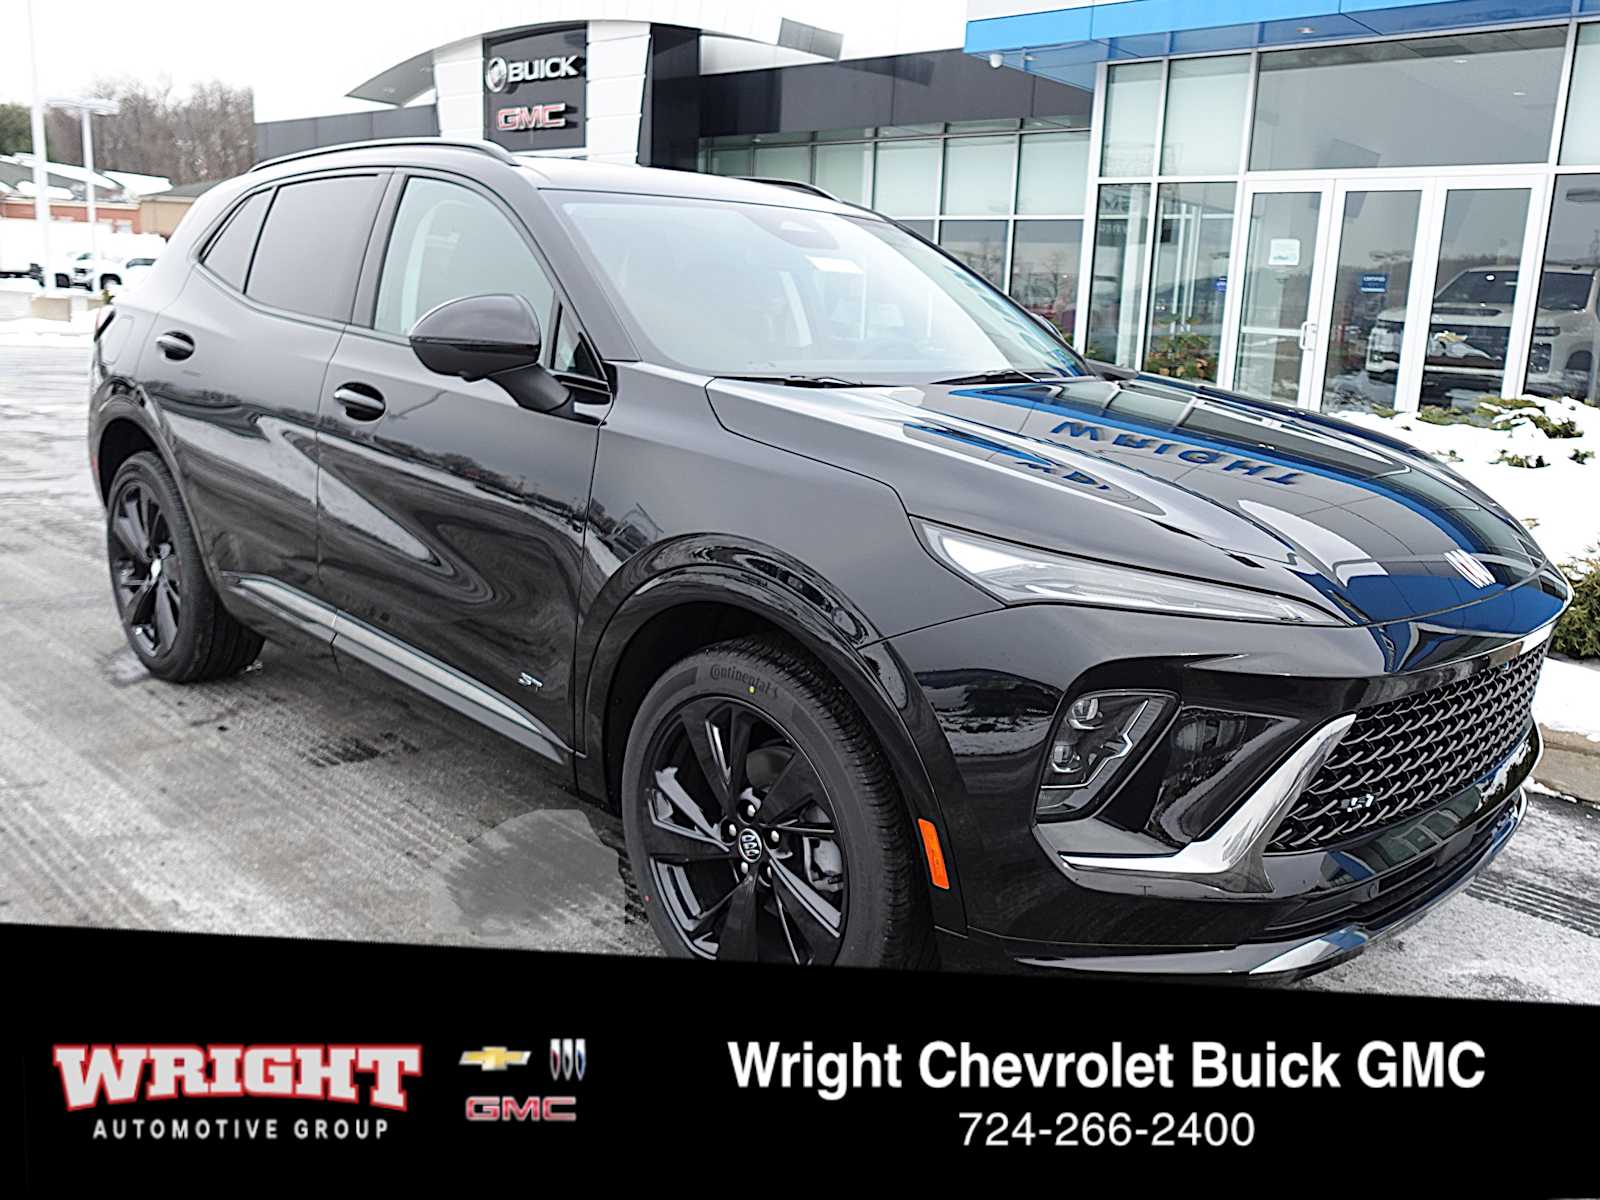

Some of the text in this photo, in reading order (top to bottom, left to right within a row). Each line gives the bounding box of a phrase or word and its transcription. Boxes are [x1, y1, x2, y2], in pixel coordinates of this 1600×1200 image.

[507, 55, 579, 82] BUICK
[497, 103, 566, 130] GMC
[710, 663, 771, 695] Continental
